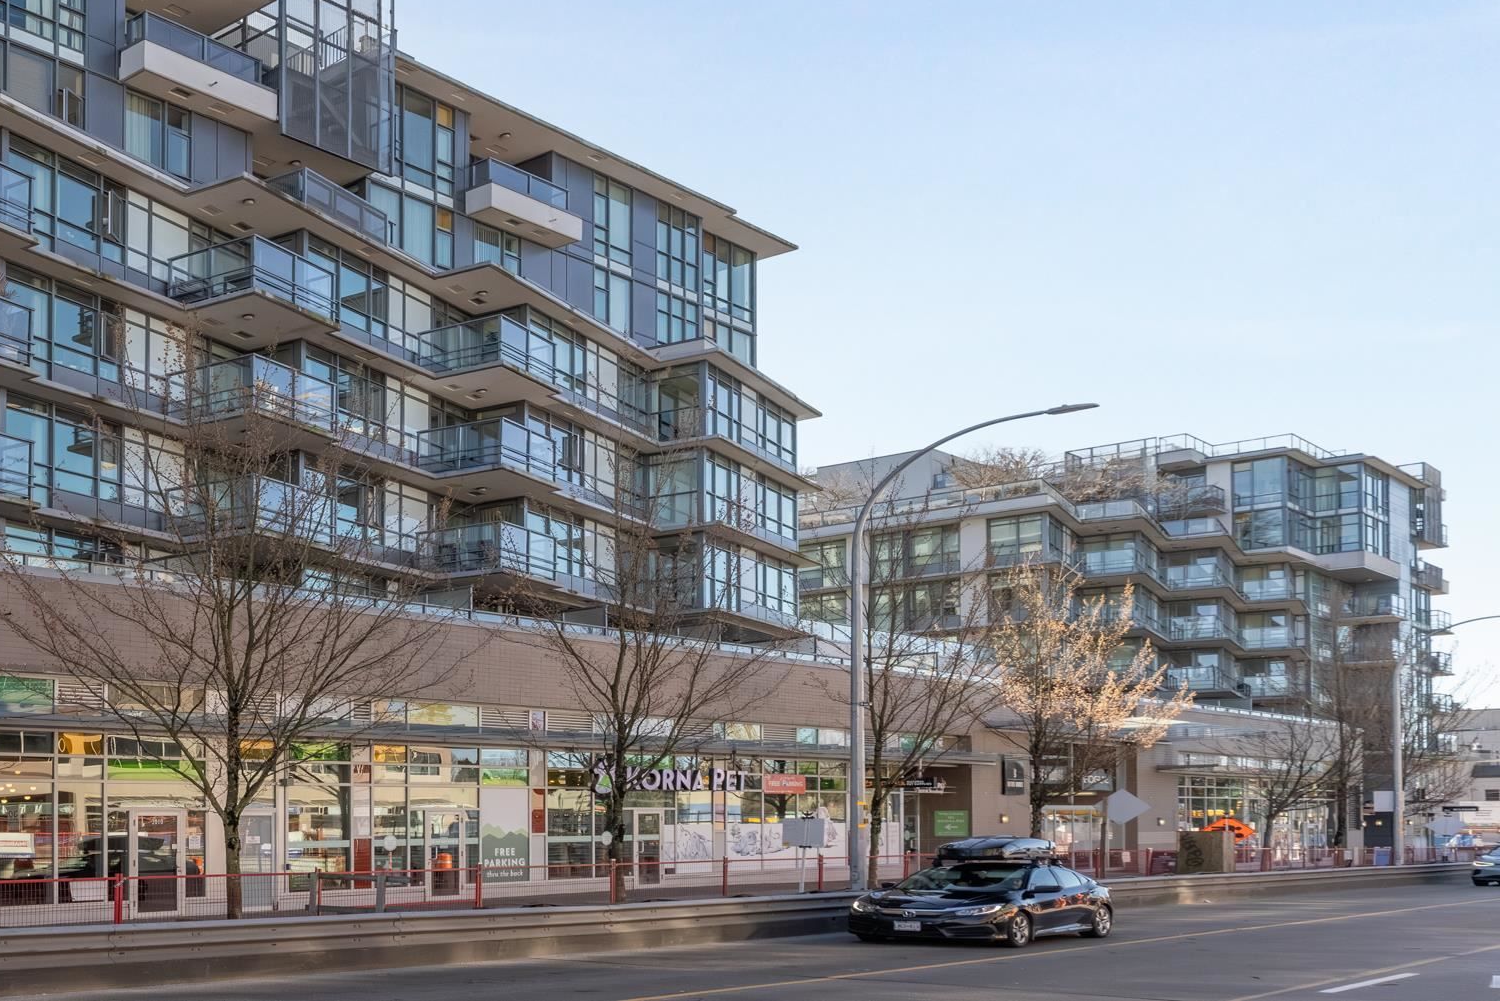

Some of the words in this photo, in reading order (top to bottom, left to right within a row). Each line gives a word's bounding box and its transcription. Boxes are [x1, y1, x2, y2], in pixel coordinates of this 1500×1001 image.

[625, 766, 705, 791] KORNA
[712, 768, 748, 791] PET
[494, 847, 516, 857] FREE
[484, 858, 526, 868] PARKING
[486, 870, 499, 878] thru
